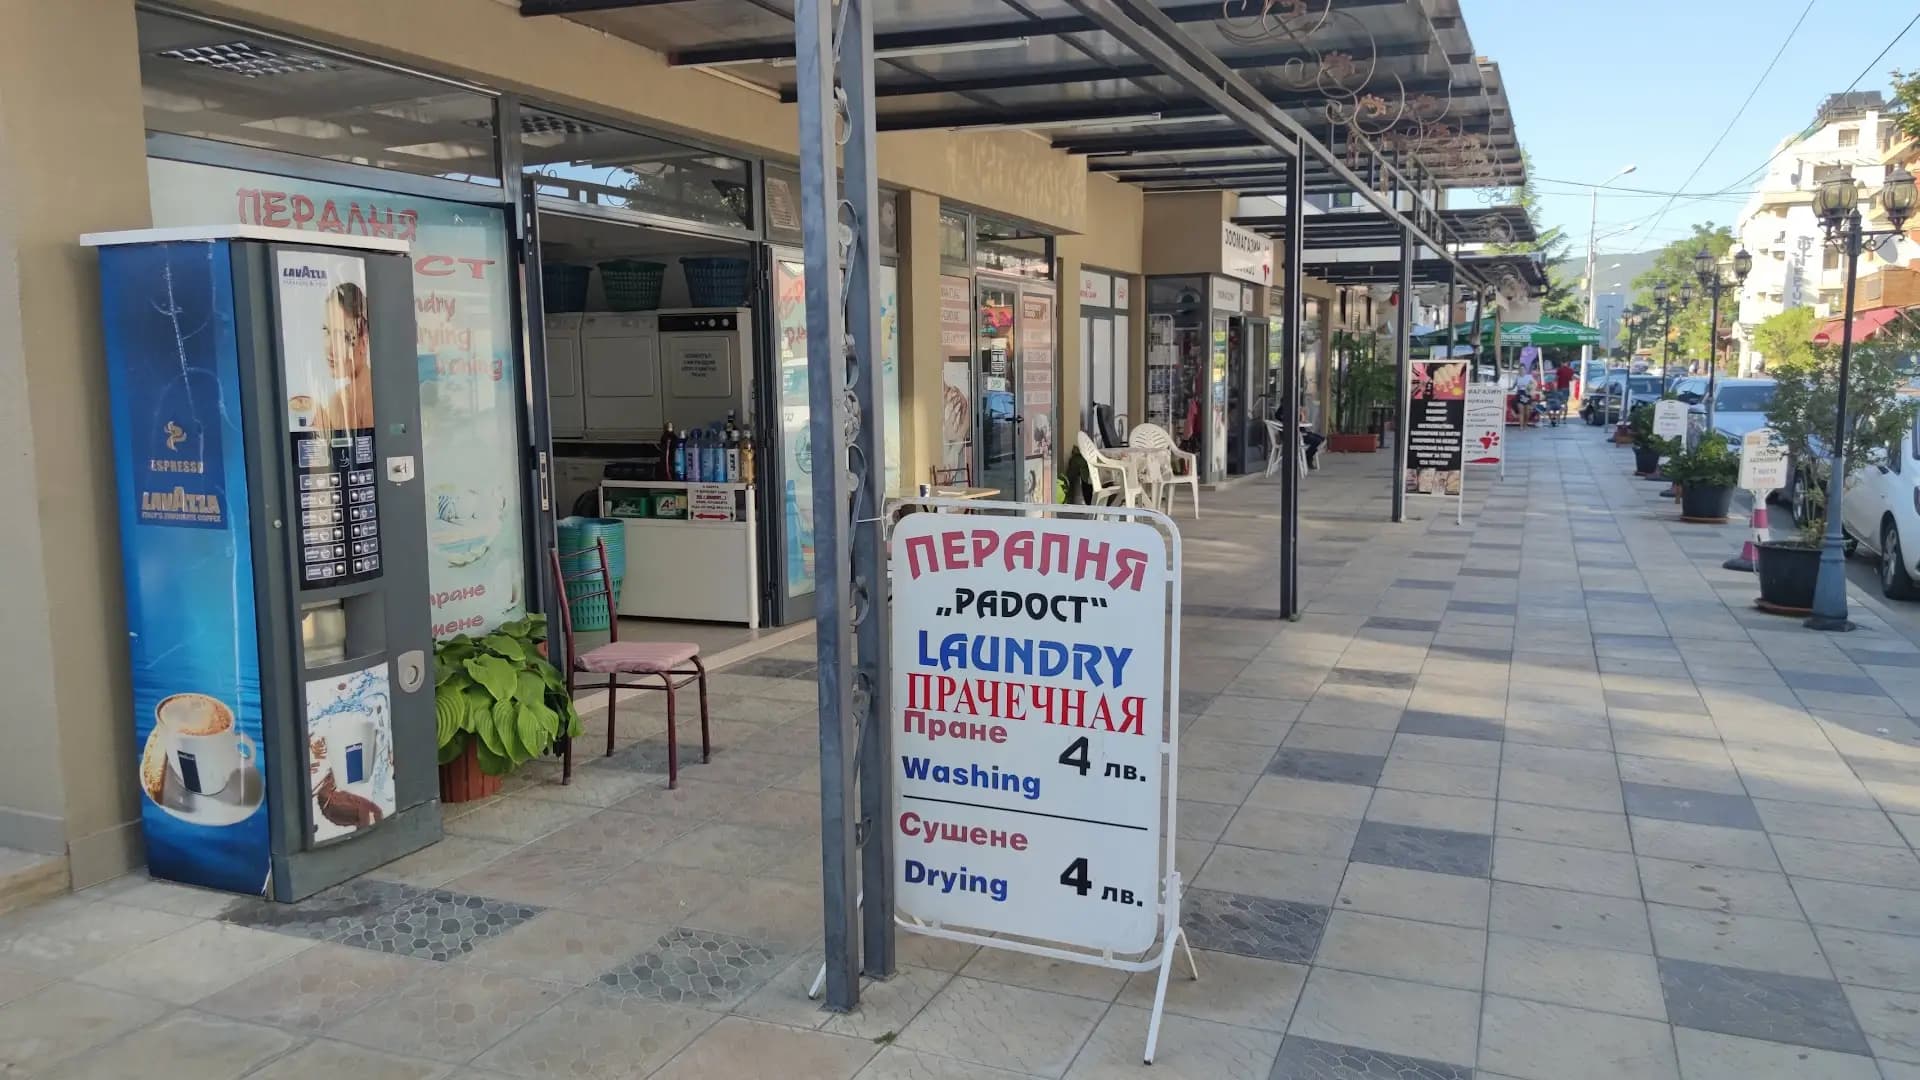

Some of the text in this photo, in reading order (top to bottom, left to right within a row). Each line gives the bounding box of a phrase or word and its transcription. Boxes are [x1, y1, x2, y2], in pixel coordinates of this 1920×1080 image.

[236, 188, 418, 241] ПЕРАЛНЯ
[283, 265, 328, 279] LAVAZZA
[151, 459, 204, 474] ESPRESSO
[142, 486, 221, 514] LAVAZZA
[905, 529, 1148, 592] ПЕРАЛНЯ
[918, 630, 1133, 688] LAUNDRY
[906, 672, 1148, 736] ПРАЧЕЧНАЯ
[904, 710, 1008, 743] Пране
[902, 756, 1041, 800] Washing
[1058, 736, 1146, 782] 4 лв.
[899, 812, 1029, 851] Сушене
[904, 859, 1008, 902] Drying
[1060, 857, 1143, 907] 4 лв.
